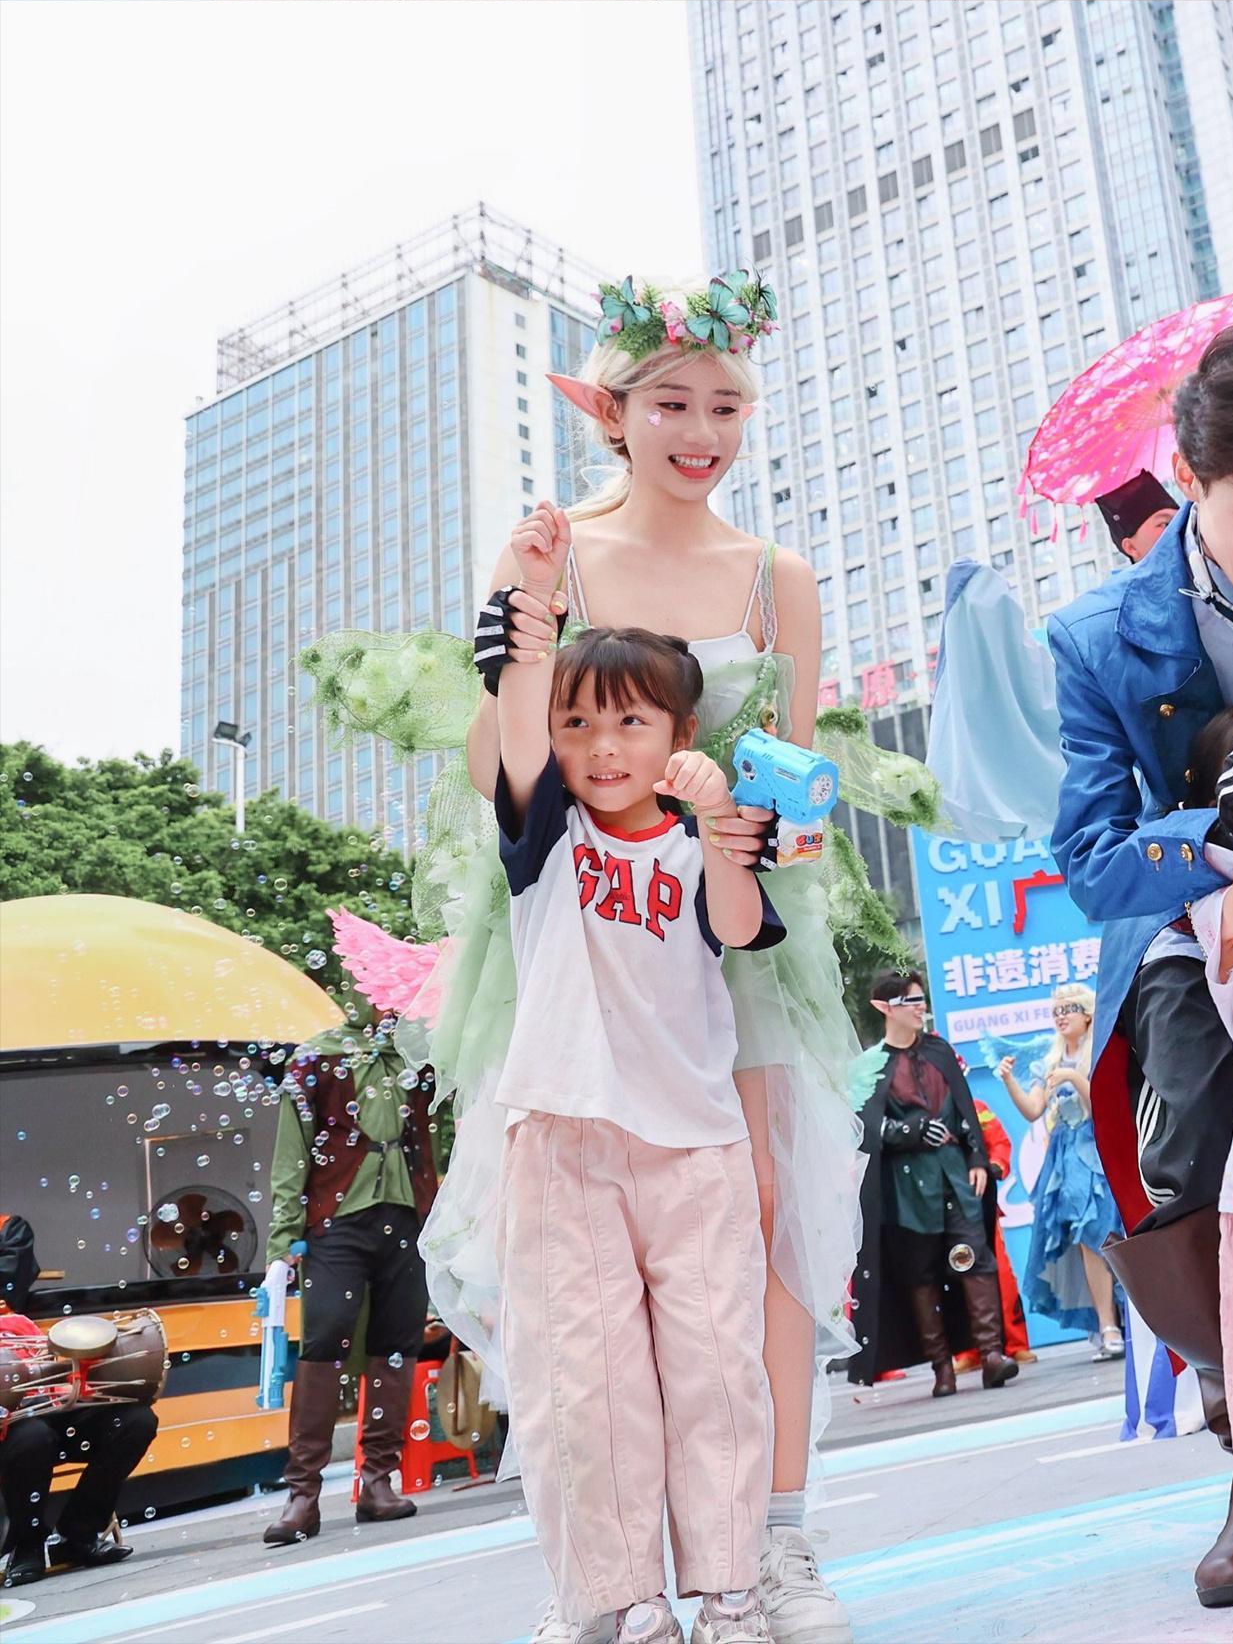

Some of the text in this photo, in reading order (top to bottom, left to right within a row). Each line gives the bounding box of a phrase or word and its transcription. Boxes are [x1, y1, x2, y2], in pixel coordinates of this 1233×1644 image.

[573, 842, 684, 943] GAP
[937, 880, 1003, 935] XI
[943, 937, 1101, 998] 非遗消费
[953, 1010, 1010, 1034] GUANG
[1014, 1008, 1030, 1023] XI
